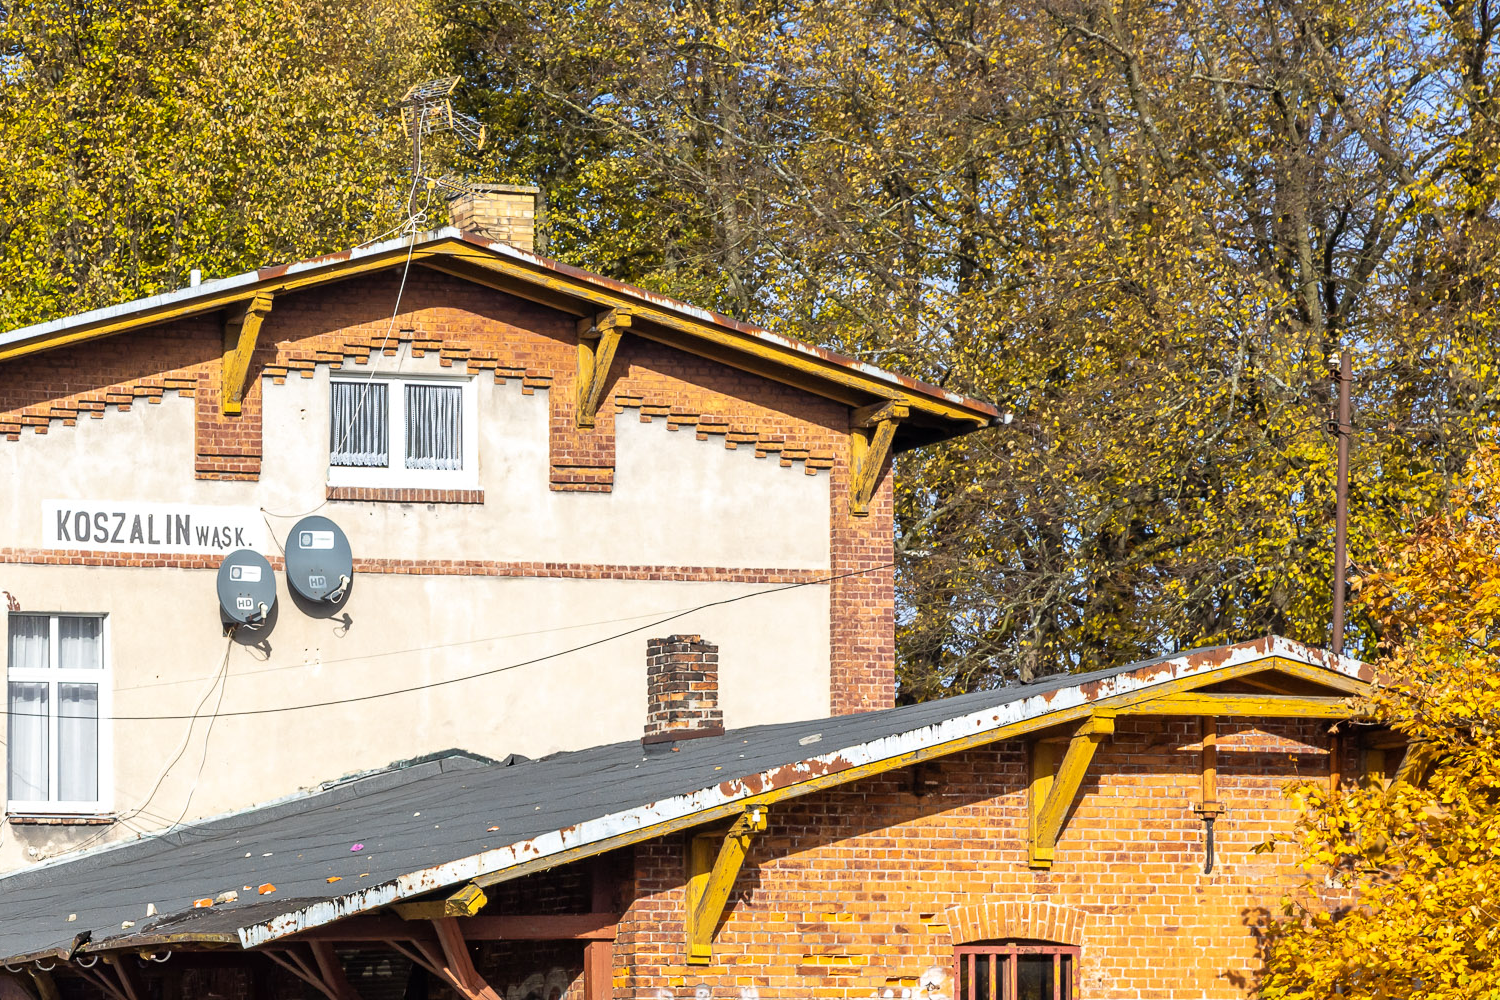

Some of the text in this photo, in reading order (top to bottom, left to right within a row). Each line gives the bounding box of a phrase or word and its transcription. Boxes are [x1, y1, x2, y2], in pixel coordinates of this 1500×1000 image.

[57, 509, 253, 549] KOSZALIN WĄSK.
[310, 577, 325, 587] HD
[238, 599, 252, 608] HD
